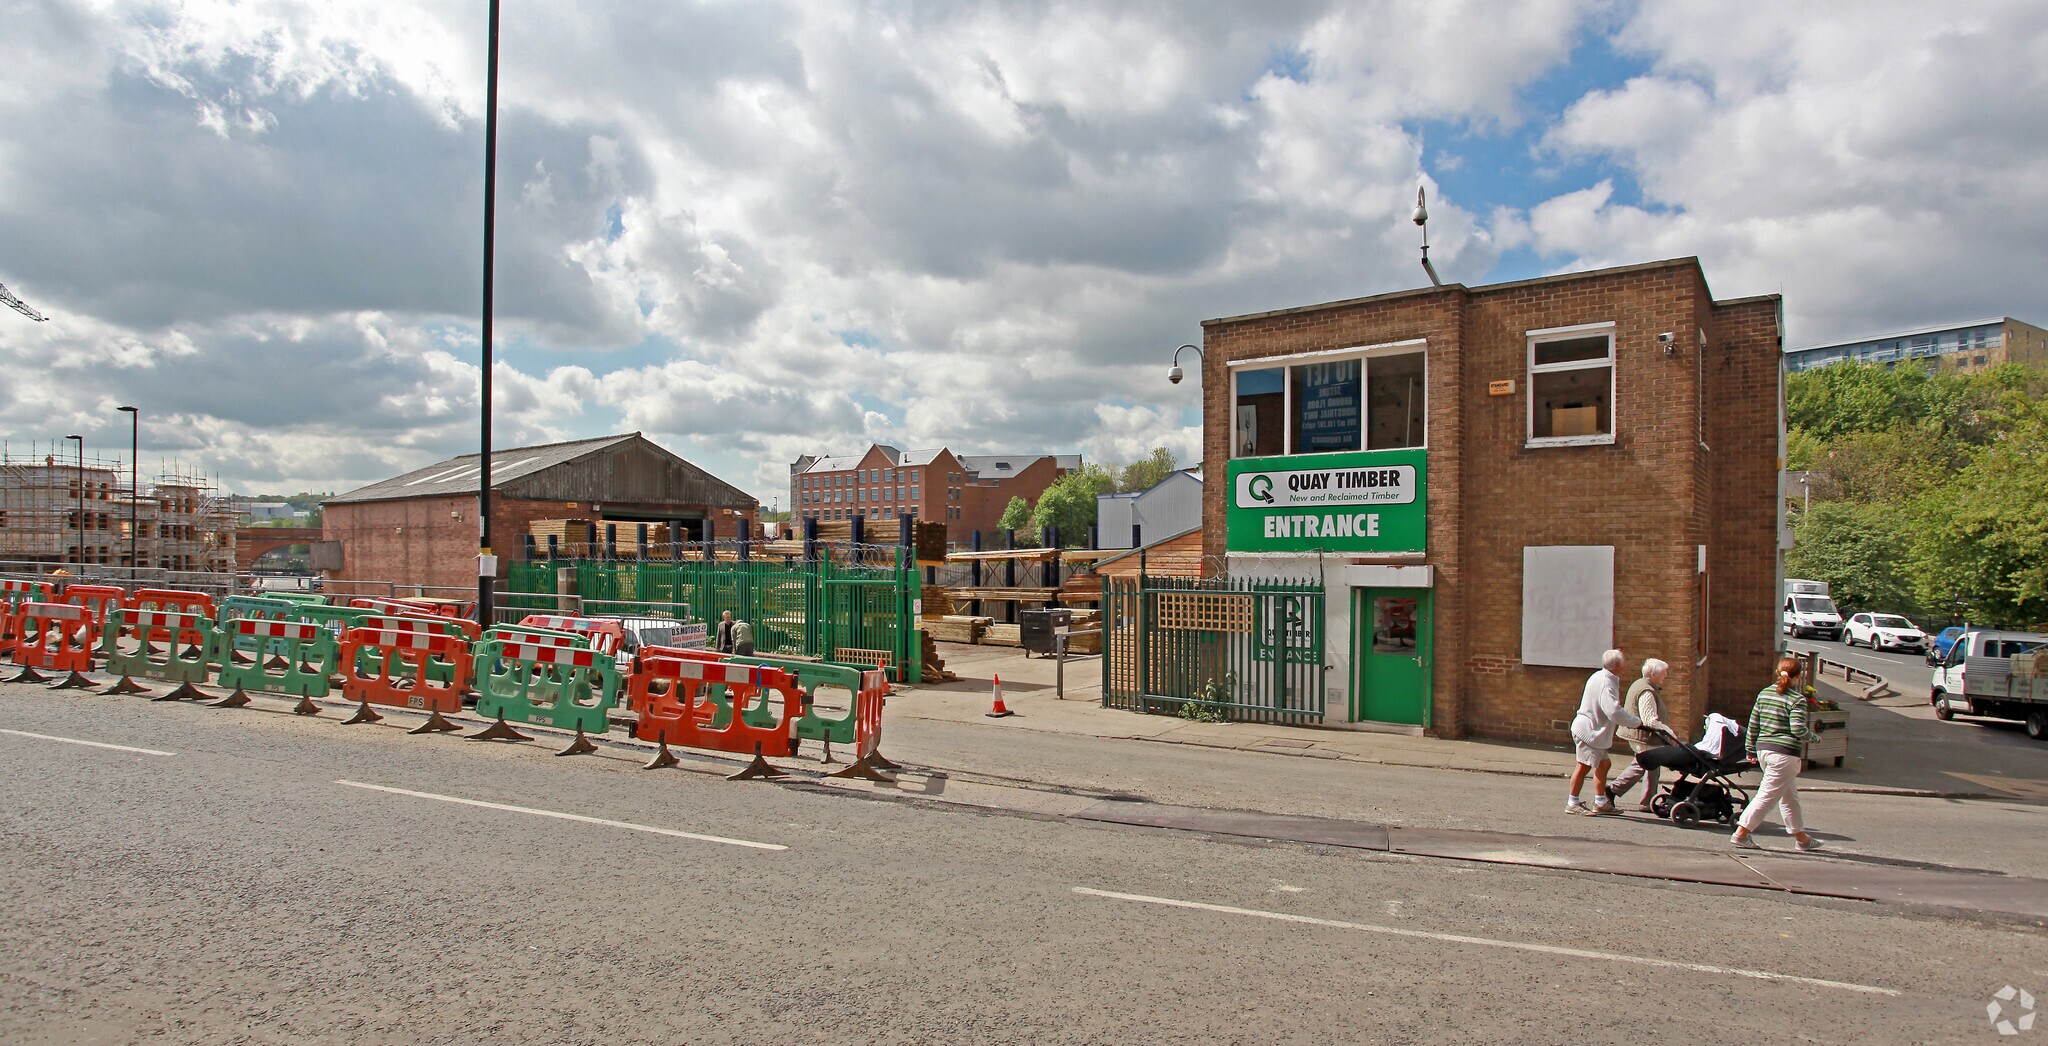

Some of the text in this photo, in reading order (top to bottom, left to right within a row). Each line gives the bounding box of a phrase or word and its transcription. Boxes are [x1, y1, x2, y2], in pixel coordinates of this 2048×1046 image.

[1288, 470, 1400, 493] QUAY TIMBER
[1289, 491, 1400, 502] New and Reclaimed Timber
[1264, 513, 1379, 538] ENTRANCE
[1260, 648, 1317, 661] ENANCE
[409, 696, 424, 706] FPS
[535, 715, 546, 723] FPS
